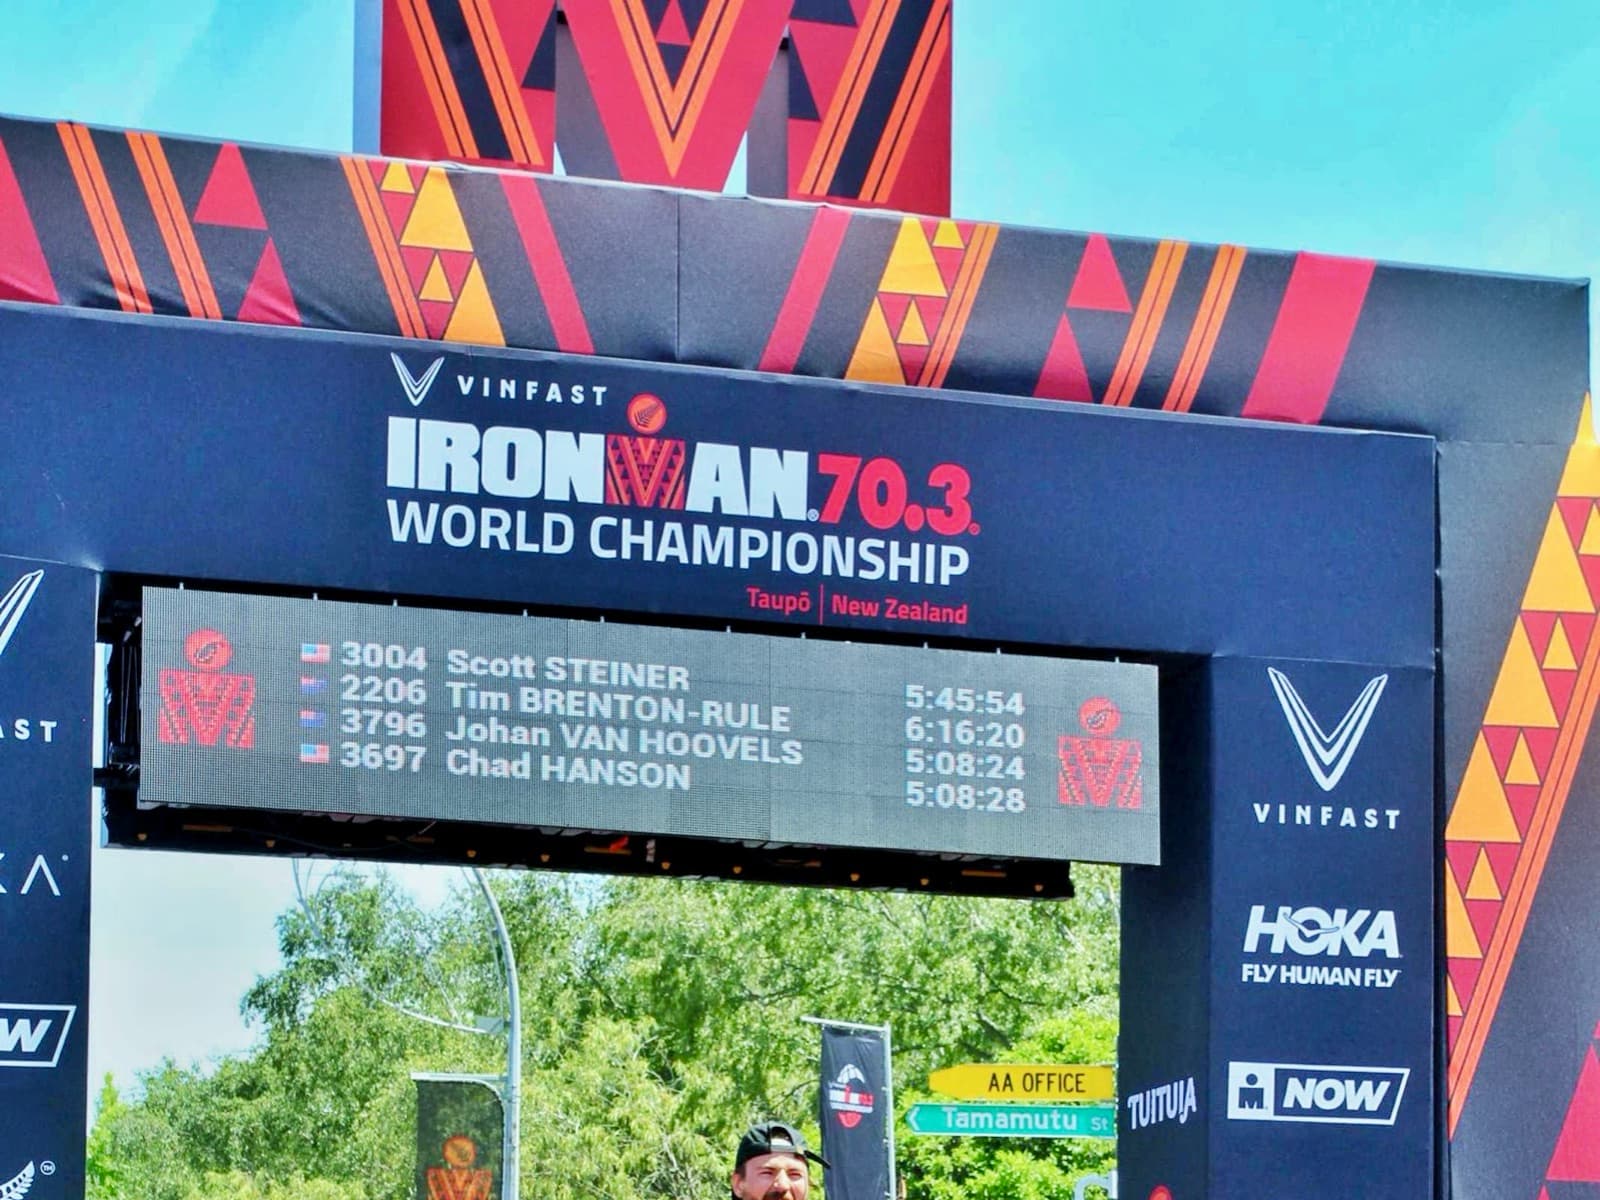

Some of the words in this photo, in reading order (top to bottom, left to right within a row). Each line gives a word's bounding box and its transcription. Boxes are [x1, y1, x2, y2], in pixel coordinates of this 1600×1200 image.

[457, 374, 608, 406] VINFAST
[386, 414, 809, 521] IRONMAN
[817, 449, 972, 536] 70.3
[386, 498, 574, 555] WORLD
[589, 514, 971, 586] CHAMPIONSHIP
[746, 586, 811, 614] Taupō
[832, 596, 879, 618] New
[885, 598, 968, 625] Zealand
[341, 641, 427, 672] 3004
[446, 648, 536, 680] Scott
[544, 656, 691, 691] STEINER
[905, 684, 1026, 716] 5:45:54
[340, 674, 427, 706] 2206
[444, 682, 509, 713] Tim
[519, 687, 791, 733] BRENTON-RULE
[905, 716, 1025, 748] 6:16:20
[340, 709, 427, 739] 3796
[445, 715, 551, 750] Johan
[558, 721, 629, 754] VAN
[637, 726, 804, 766] HOOVELS
[906, 749, 1026, 780] 5:08:24
[340, 742, 426, 773] 3697
[446, 749, 530, 781] Chad
[540, 757, 691, 791] HANSON
[906, 781, 1026, 813] 5:08:28
[1252, 803, 1401, 830] VINFAST
[1242, 904, 1402, 959] HOKA
[1241, 964, 1276, 984] FLY
[1280, 965, 1362, 987] HUMAN
[1364, 968, 1398, 989] FLY
[987, 1073, 1014, 1093] AA
[1022, 1073, 1086, 1093] OFFICE
[1282, 1077, 1392, 1112] NOW
[941, 1107, 1077, 1131] Tamamutu
[1090, 1118, 1108, 1131] St
